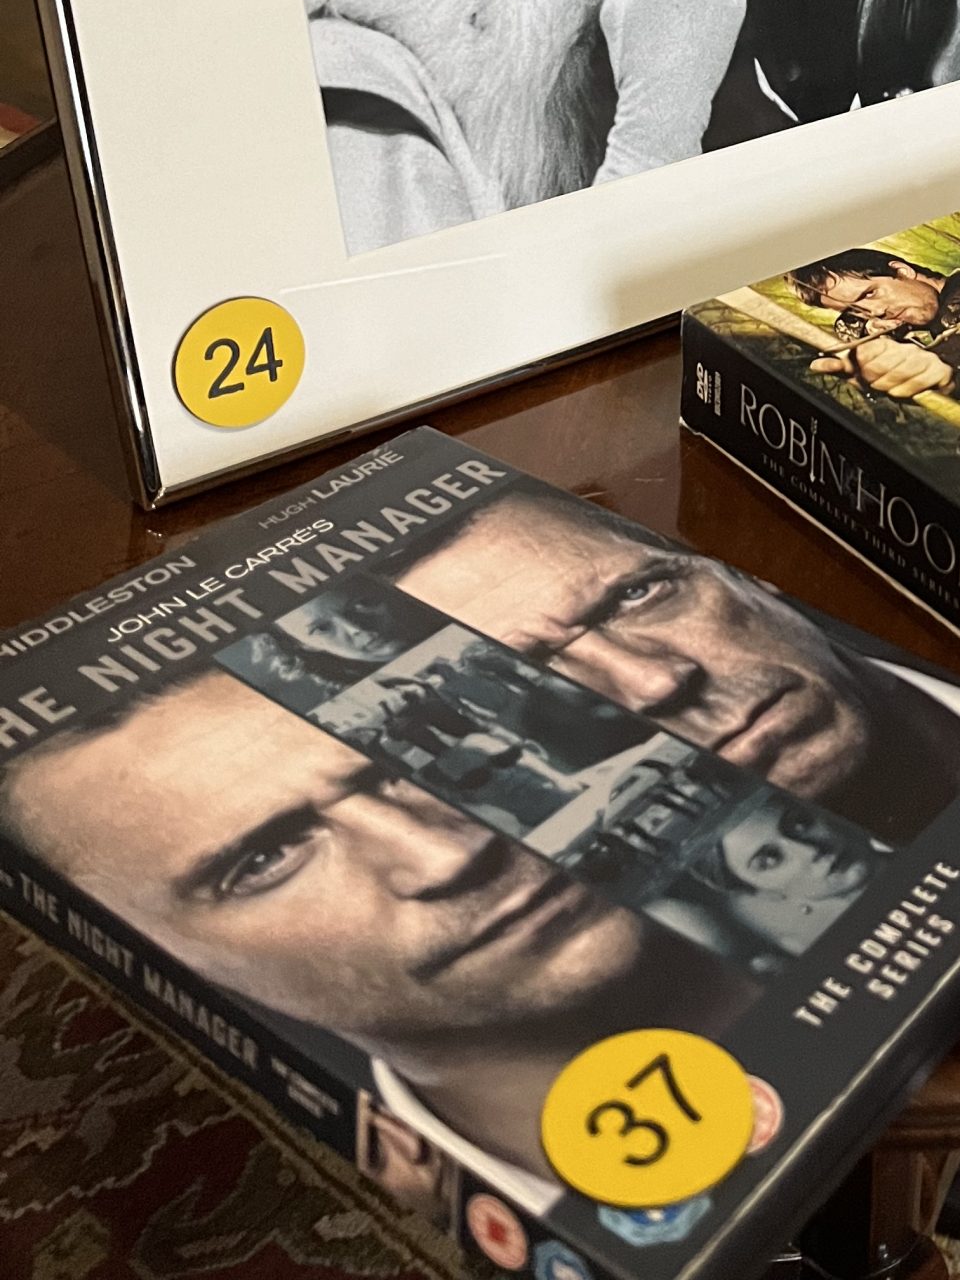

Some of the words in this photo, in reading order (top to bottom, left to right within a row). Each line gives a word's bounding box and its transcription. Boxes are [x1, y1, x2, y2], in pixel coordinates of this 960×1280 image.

[205, 327, 283, 399] 24
[696, 362, 704, 400] DVD
[259, 496, 314, 530] HUGH
[314, 449, 403, 500] LAURIE
[740, 384, 846, 495] ROBIN
[762, 454, 784, 476] THE
[791, 476, 857, 531] COMPLETE
[864, 528, 906, 567] THIRD
[913, 567, 959, 609] SERIES
[0, 686, 77, 748] HE
[77, 587, 263, 694] NIGHT
[268, 455, 508, 593] MANAGER
[108, 596, 188, 642] JOHN
[186, 576, 224, 601] LE
[19, 873, 59, 923] THE
[67, 909, 134, 977] NIGHT
[143, 964, 259, 1069] MANAGER
[795, 976, 850, 1028] THE
[845, 860, 960, 975] COMPLETE
[869, 915, 955, 1001] SERIES
[586, 1052, 701, 1168] 37
